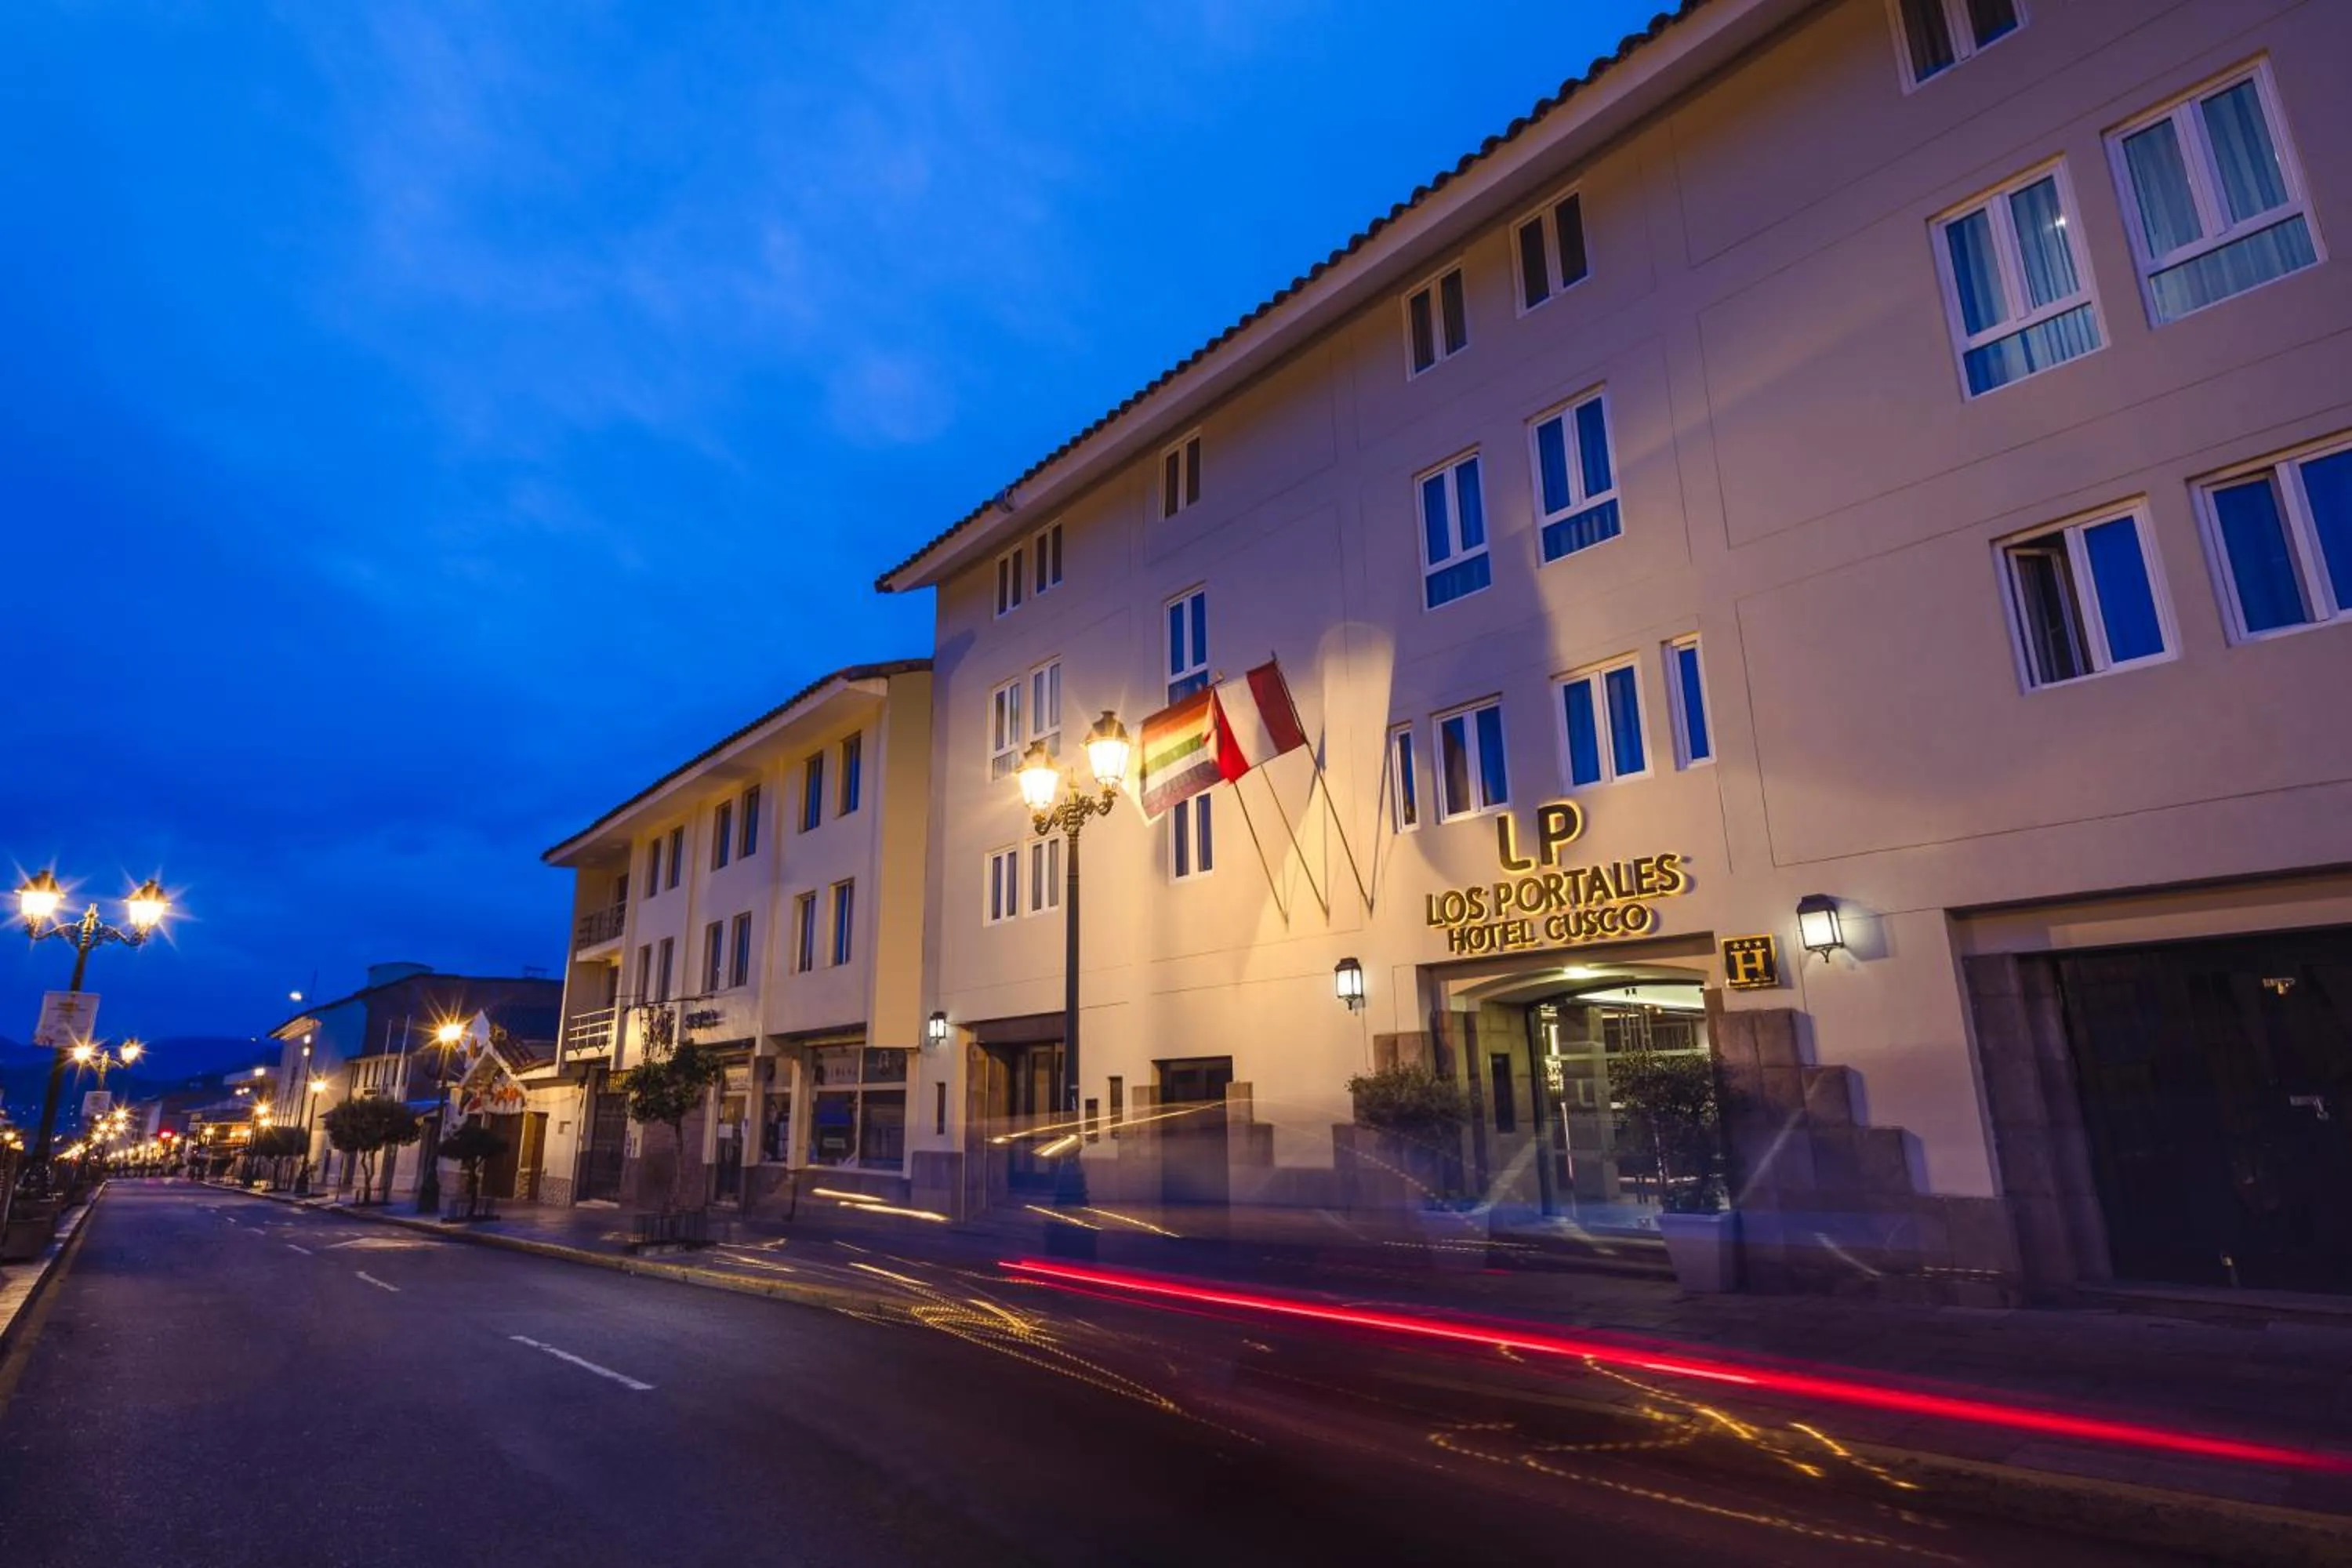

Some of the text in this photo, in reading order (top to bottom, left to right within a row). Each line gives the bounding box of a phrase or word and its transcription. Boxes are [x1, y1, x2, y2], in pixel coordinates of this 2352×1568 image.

[1497, 802, 1581, 872] LP
[1425, 853, 1682, 926] LOS PORTALES
[1447, 903, 1650, 953] HOTEL CUSCO
[1730, 948, 1766, 982] H
